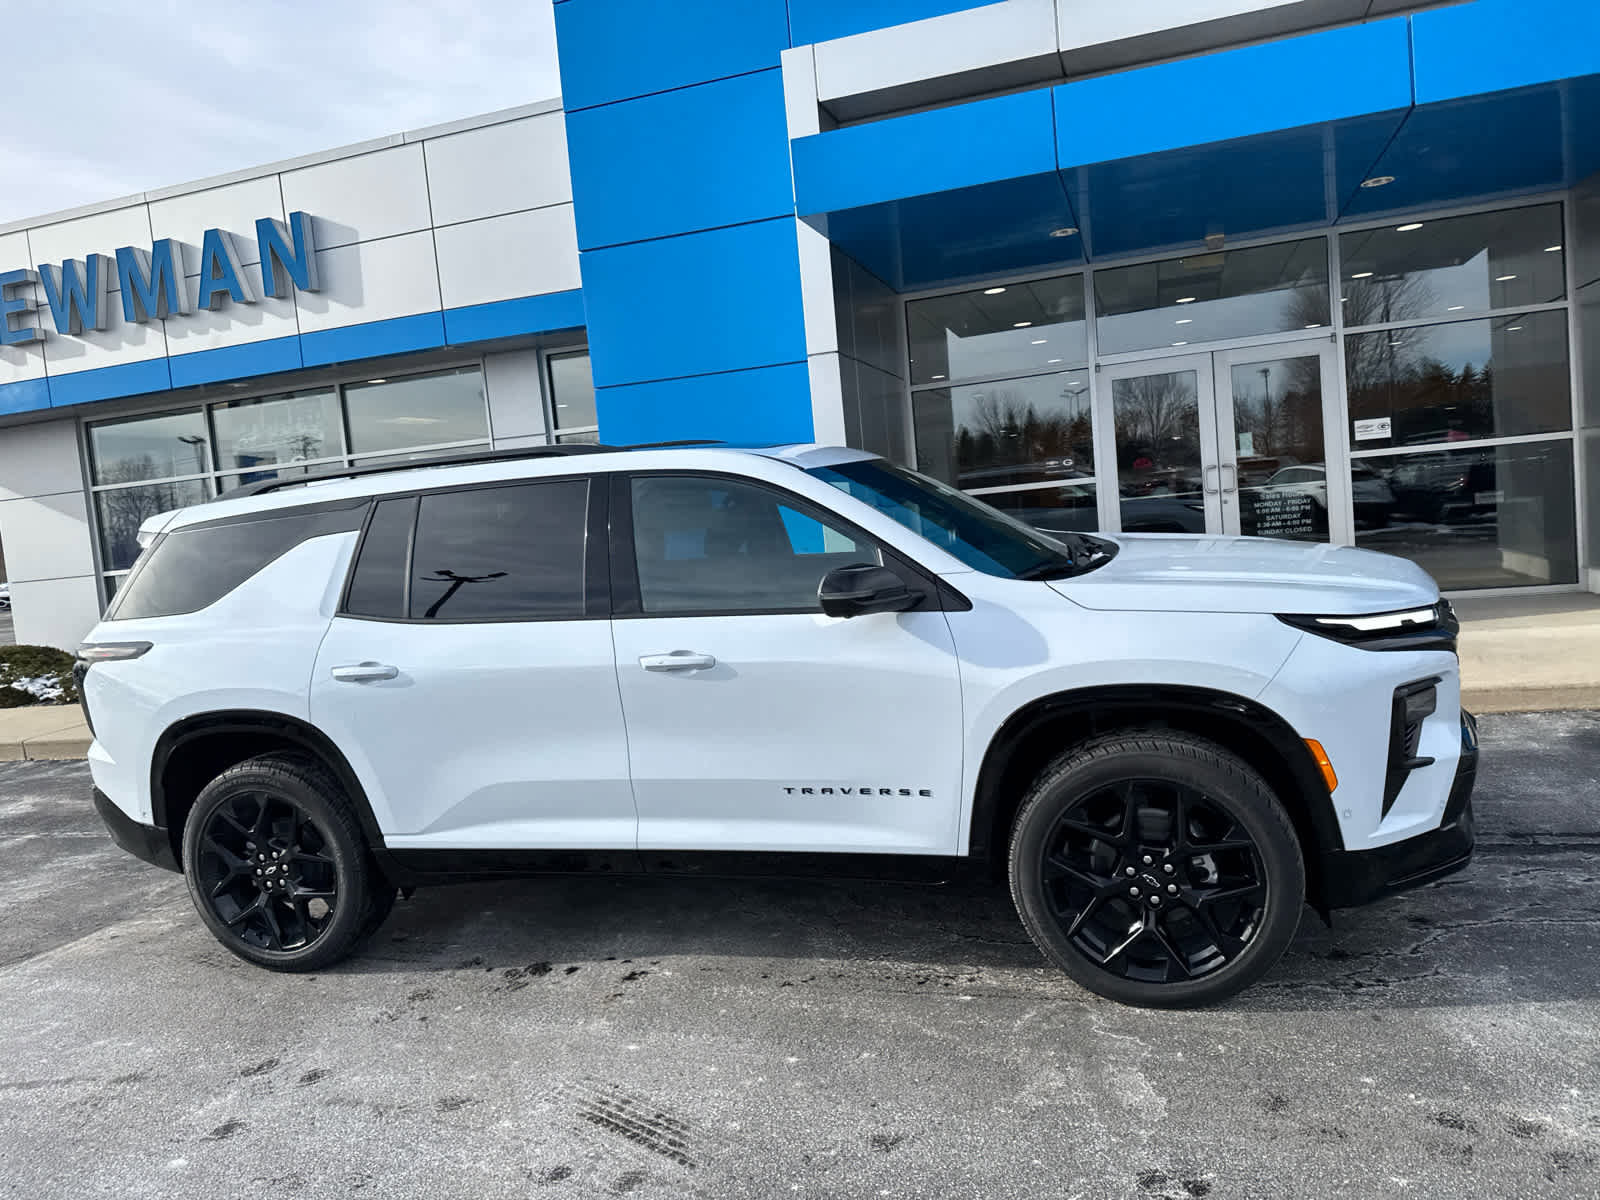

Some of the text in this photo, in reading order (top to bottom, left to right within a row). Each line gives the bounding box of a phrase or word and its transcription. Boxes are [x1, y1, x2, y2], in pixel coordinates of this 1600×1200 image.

[0, 211, 320, 347] EWMAN
[1254, 500, 1282, 508] MONDAY
[1266, 513, 1302, 521] SATURDAY
[783, 787, 933, 797] TRAVERSE
